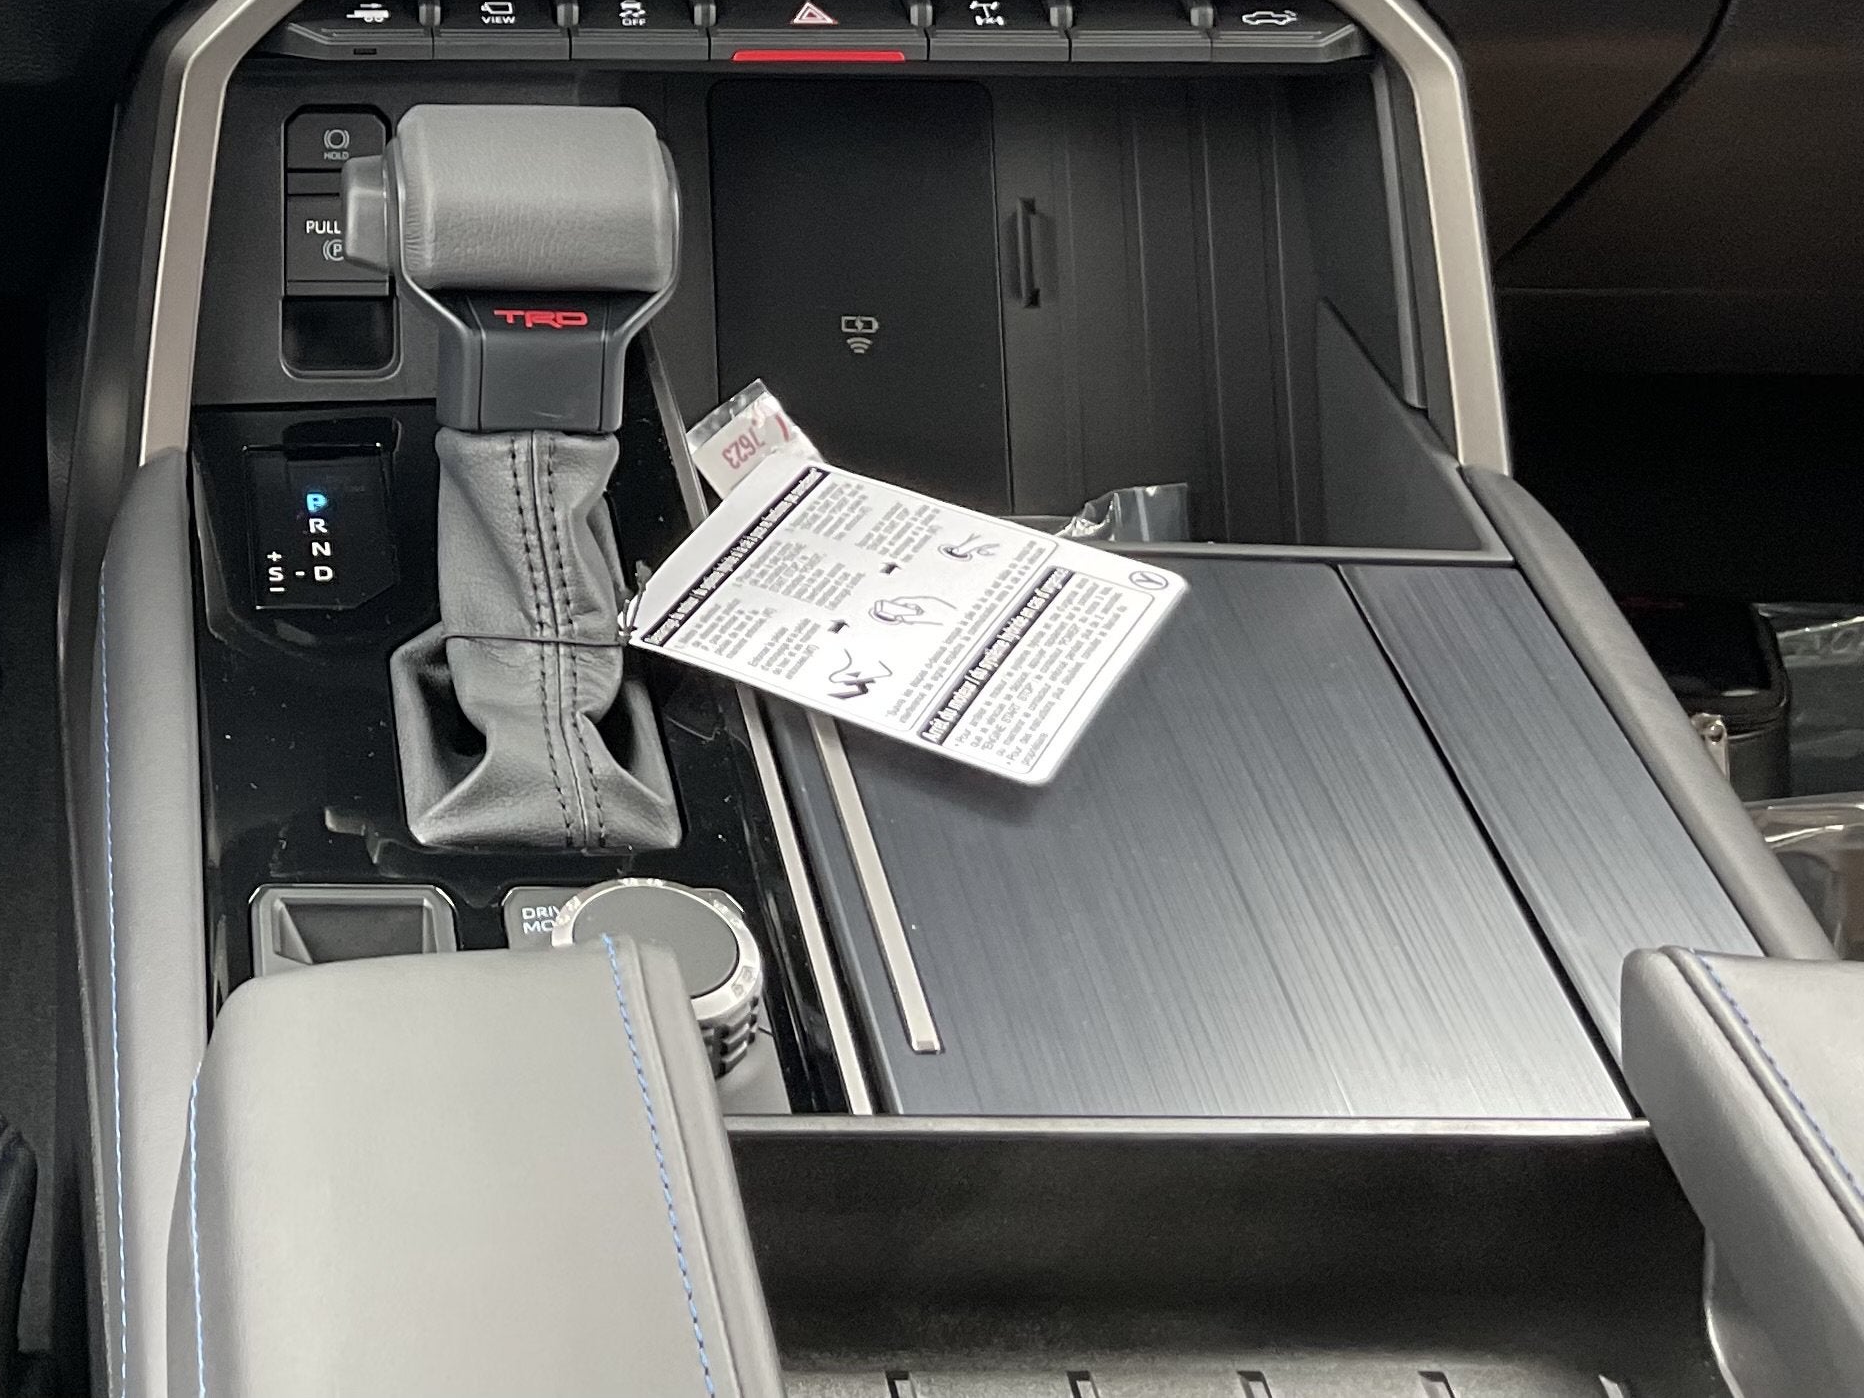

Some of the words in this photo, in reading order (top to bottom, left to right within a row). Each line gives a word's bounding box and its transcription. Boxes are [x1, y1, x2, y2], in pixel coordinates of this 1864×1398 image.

[481, 15, 516, 24] VIEW
[621, 18, 647, 27] OFF
[323, 151, 350, 160] HOLD
[305, 220, 341, 234] PULL
[493, 309, 588, 328] TRD
[306, 493, 328, 513] P
[309, 517, 328, 534] R
[311, 541, 332, 557] N
[268, 566, 284, 582] S
[313, 565, 334, 582] D
